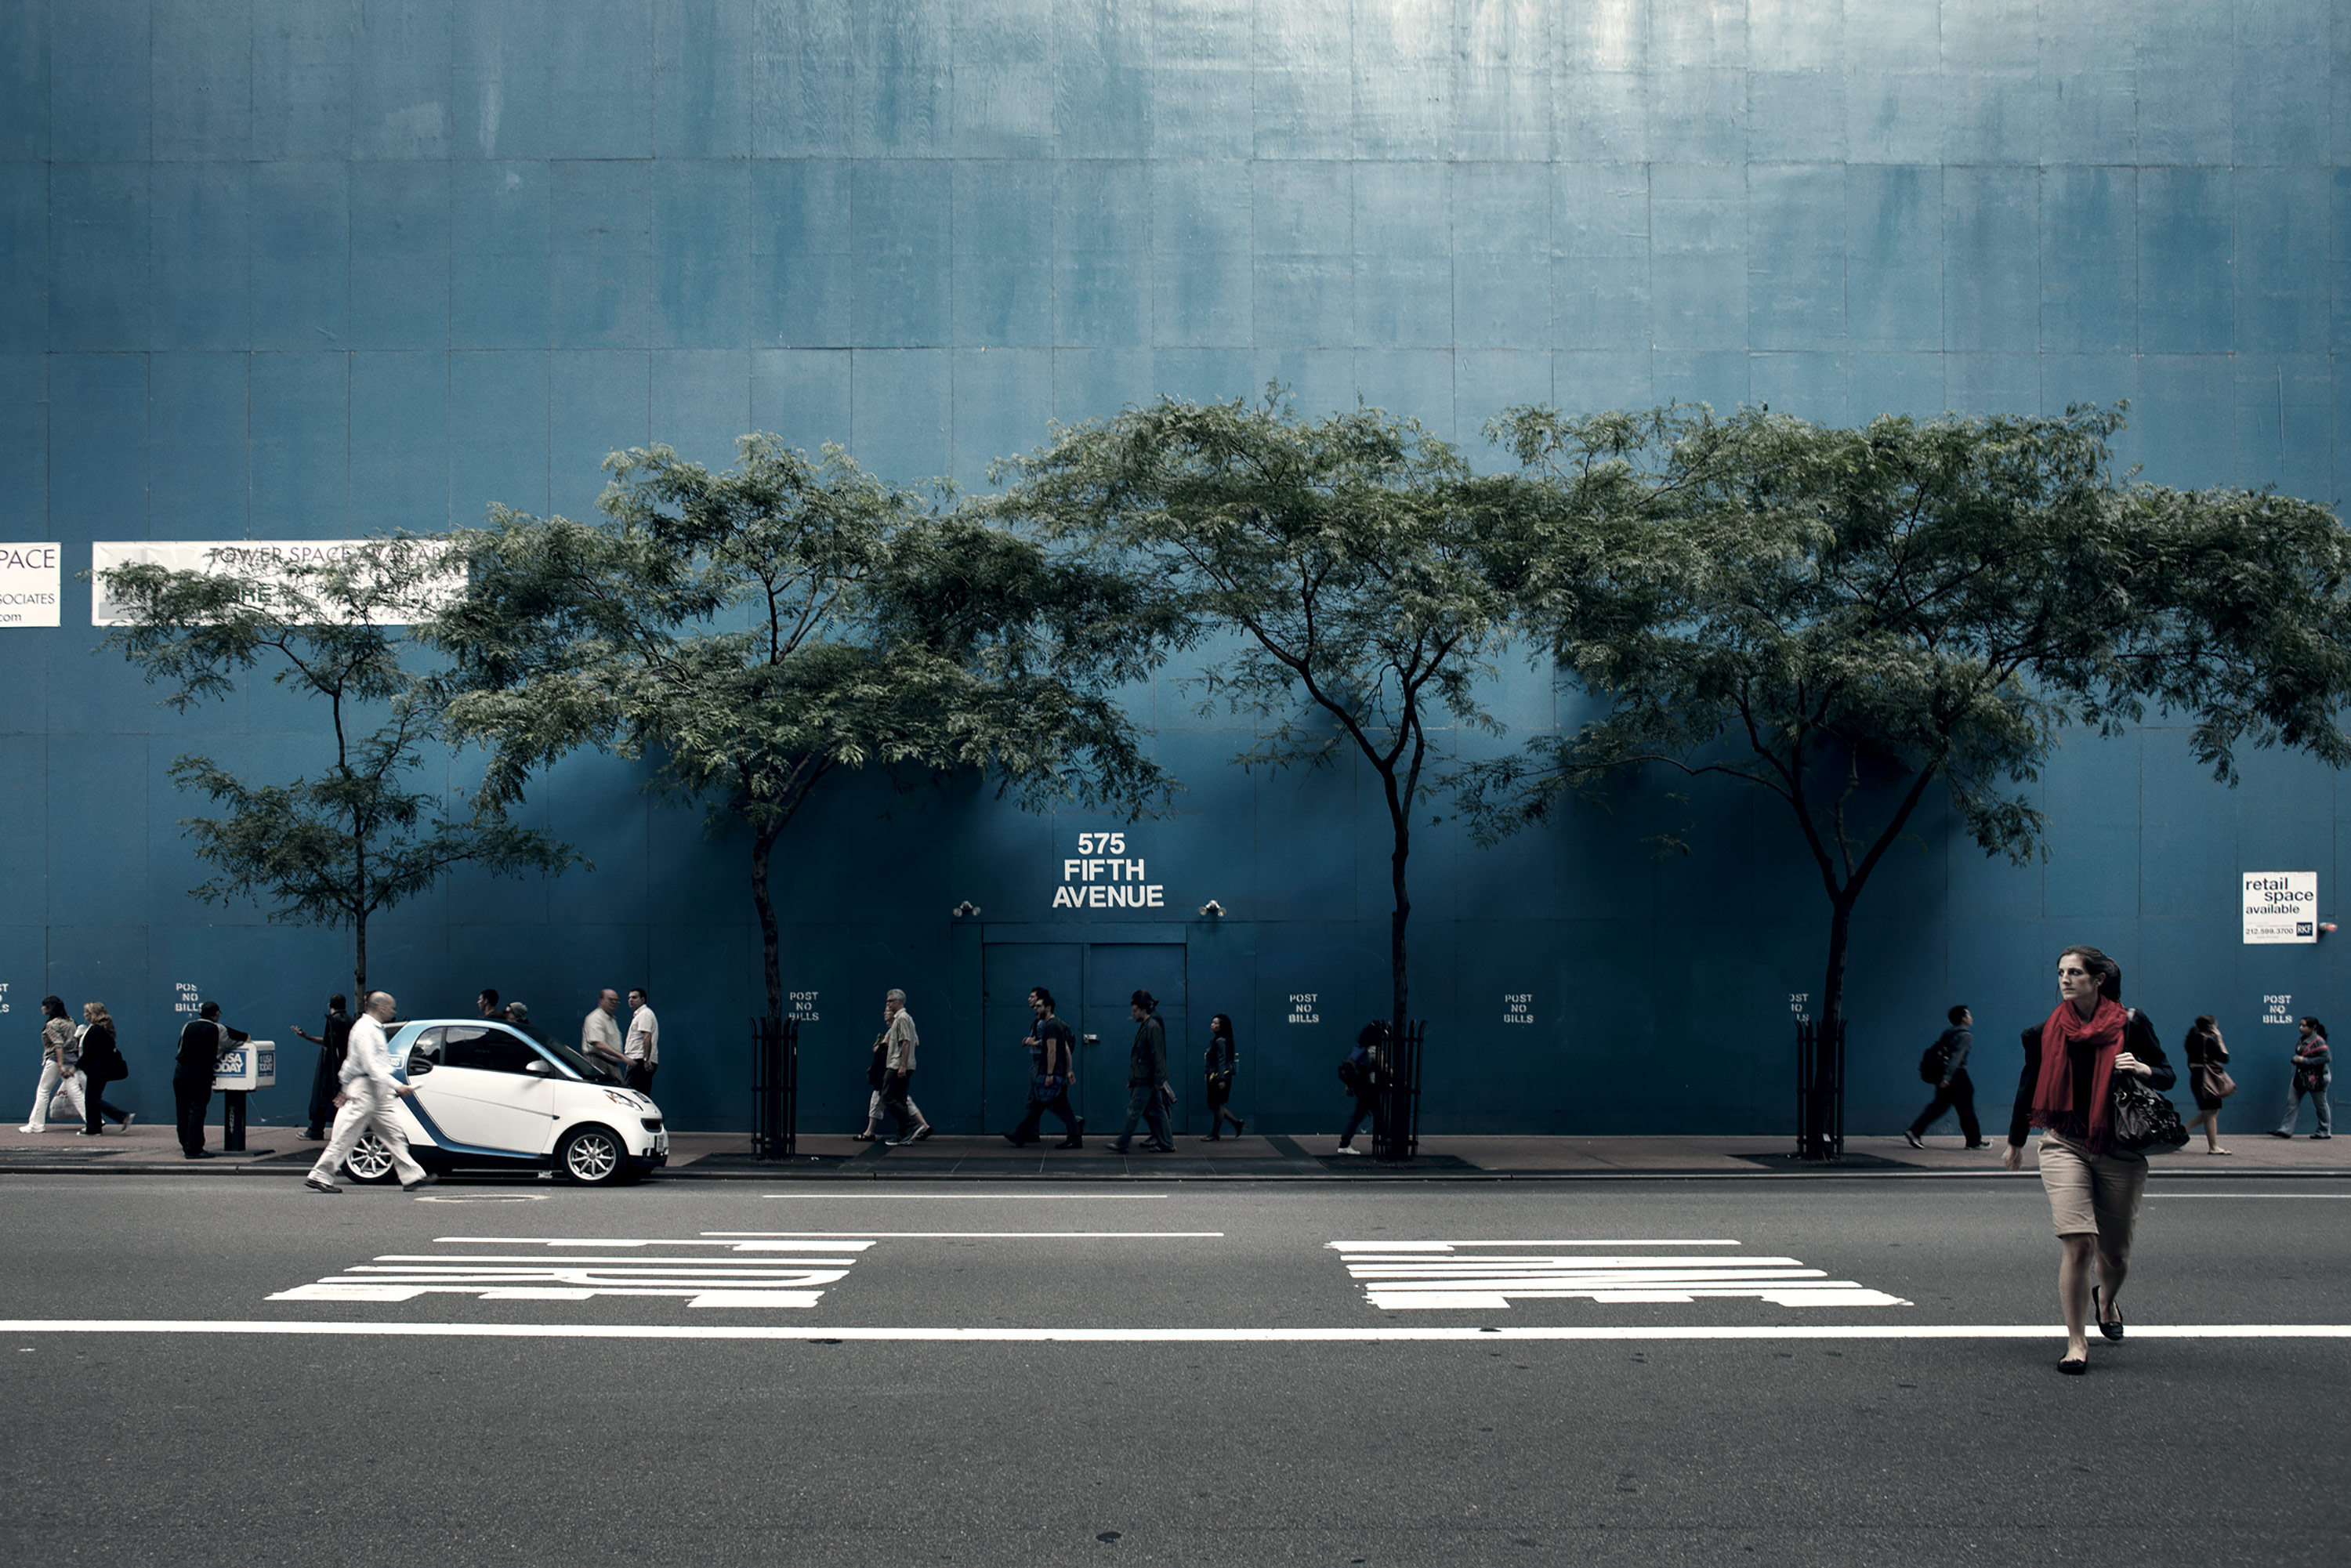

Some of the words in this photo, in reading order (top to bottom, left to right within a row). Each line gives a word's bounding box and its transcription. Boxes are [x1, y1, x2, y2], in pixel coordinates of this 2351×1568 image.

[209, 546, 282, 563] TOWER
[290, 546, 353, 563] SPACE
[0, 593, 55, 605] OCIATES
[1078, 832, 1125, 855] 575
[1064, 859, 1145, 882] FIFTH
[2245, 877, 2288, 891] retail
[1052, 885, 1165, 908] AVENUE
[2264, 891, 2314, 904] space
[2245, 904, 2300, 914] available
[176, 983, 197, 992] POS
[182, 993, 199, 1001] NO
[790, 991, 819, 1001] POST
[1289, 994, 1318, 1003] POST
[1505, 994, 1533, 1003] POST
[1788, 993, 1809, 1002] OST
[2263, 994, 2292, 1004] POST
[795, 1001, 813, 1011] NO
[1295, 1004, 1312, 1012] NO
[1511, 1004, 1527, 1013] NO
[2269, 1005, 2286, 1014] NO
[788, 1012, 820, 1021] BILLS
[1288, 1014, 1320, 1023] BILLS
[1503, 1014, 1534, 1023] BILLS
[2262, 1015, 2293, 1024] BILLS
[213, 1063, 244, 1073] ODAY
